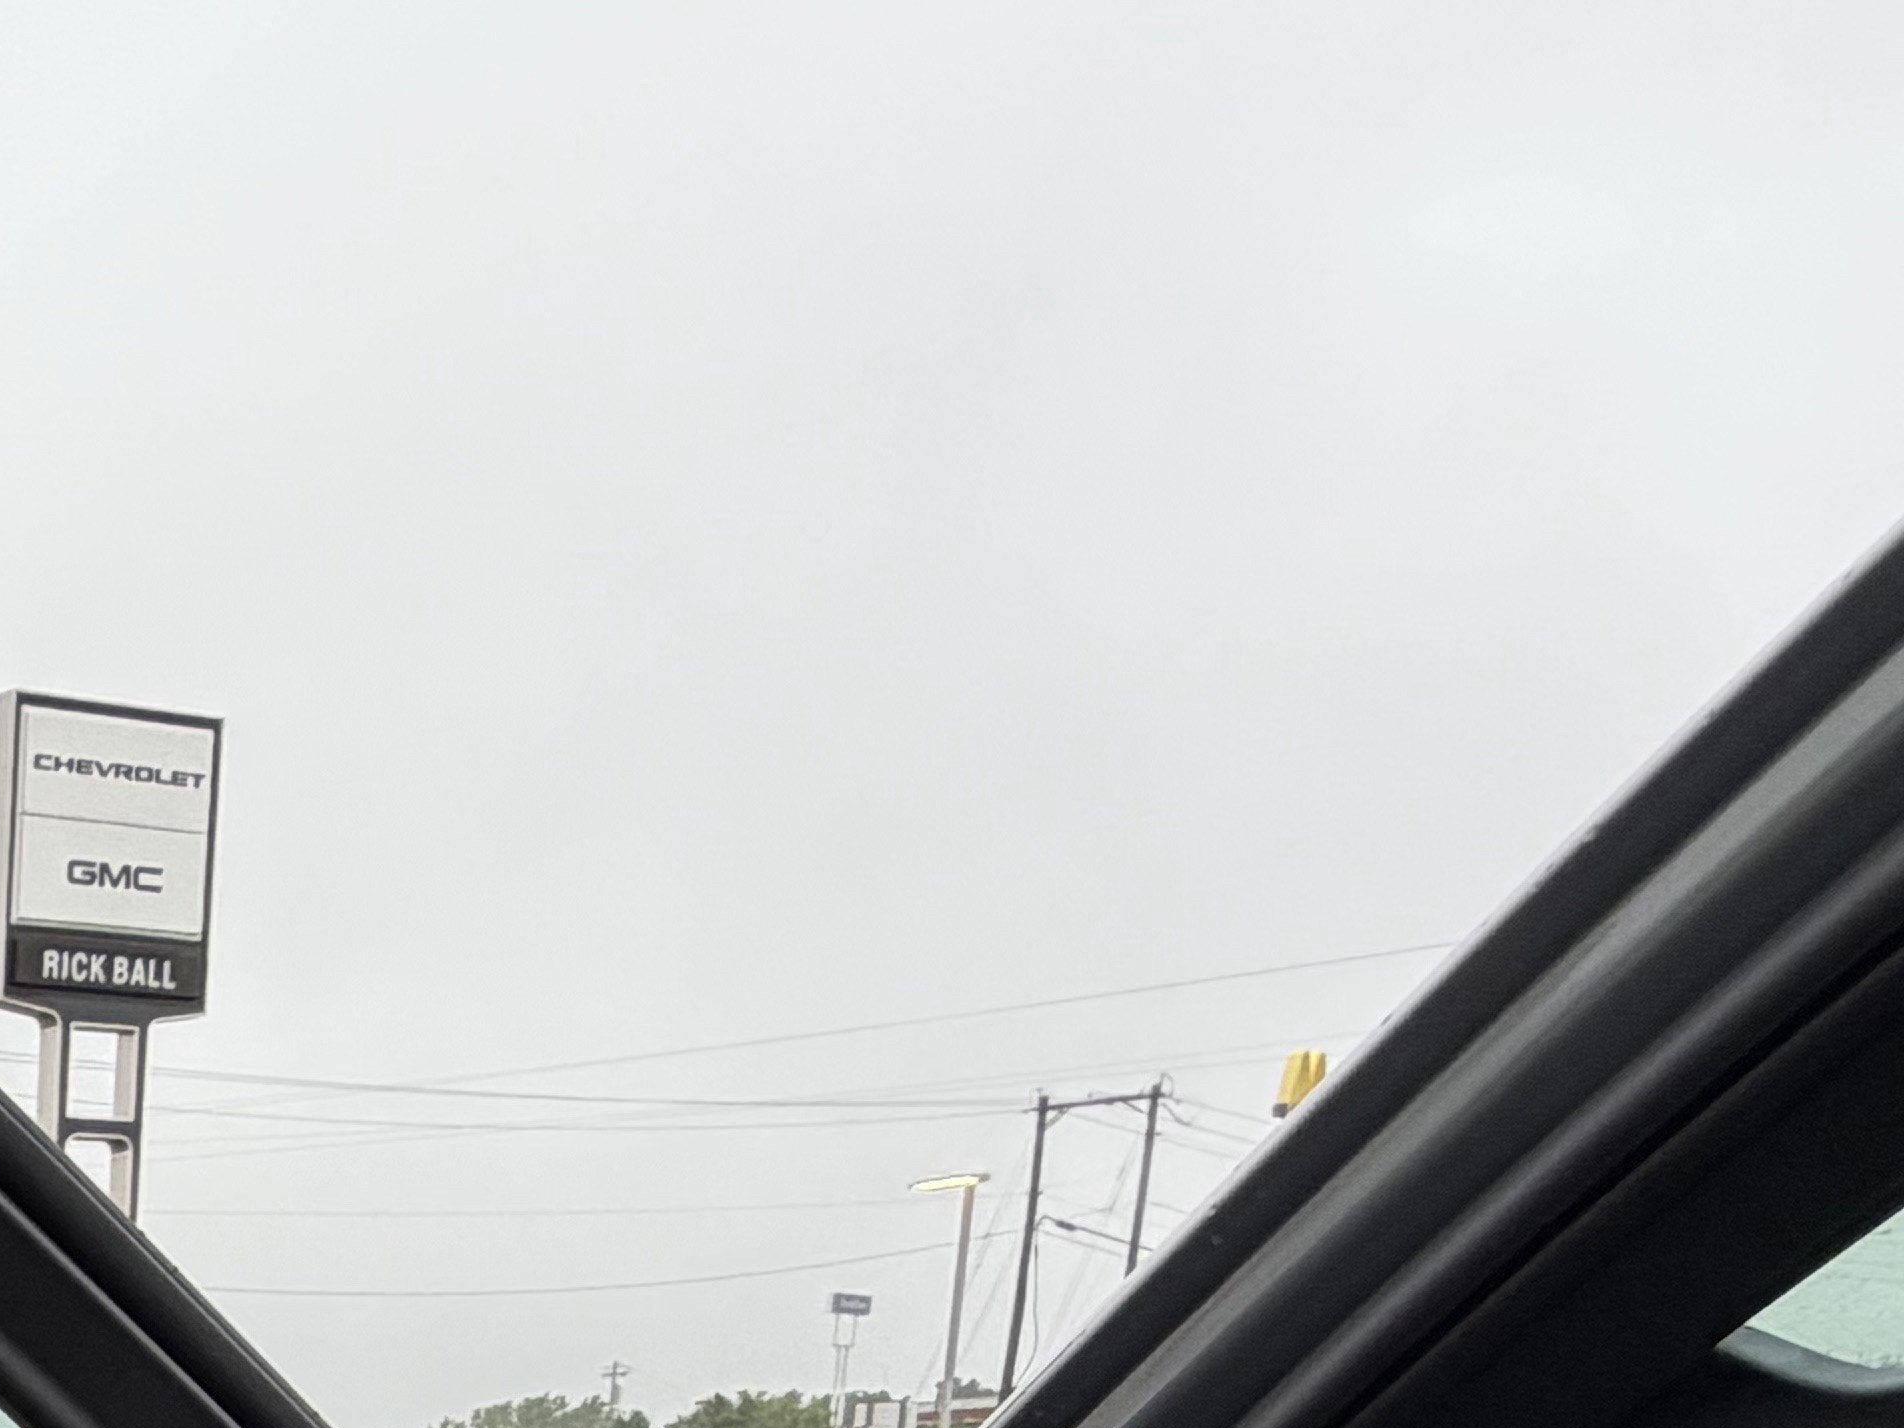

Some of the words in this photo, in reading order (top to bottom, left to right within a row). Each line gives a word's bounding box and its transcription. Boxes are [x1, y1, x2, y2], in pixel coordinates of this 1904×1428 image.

[33, 753, 206, 790] CHEVROLET
[66, 859, 164, 894] GMC
[42, 949, 108, 984] RICK
[113, 956, 177, 991] BALL
